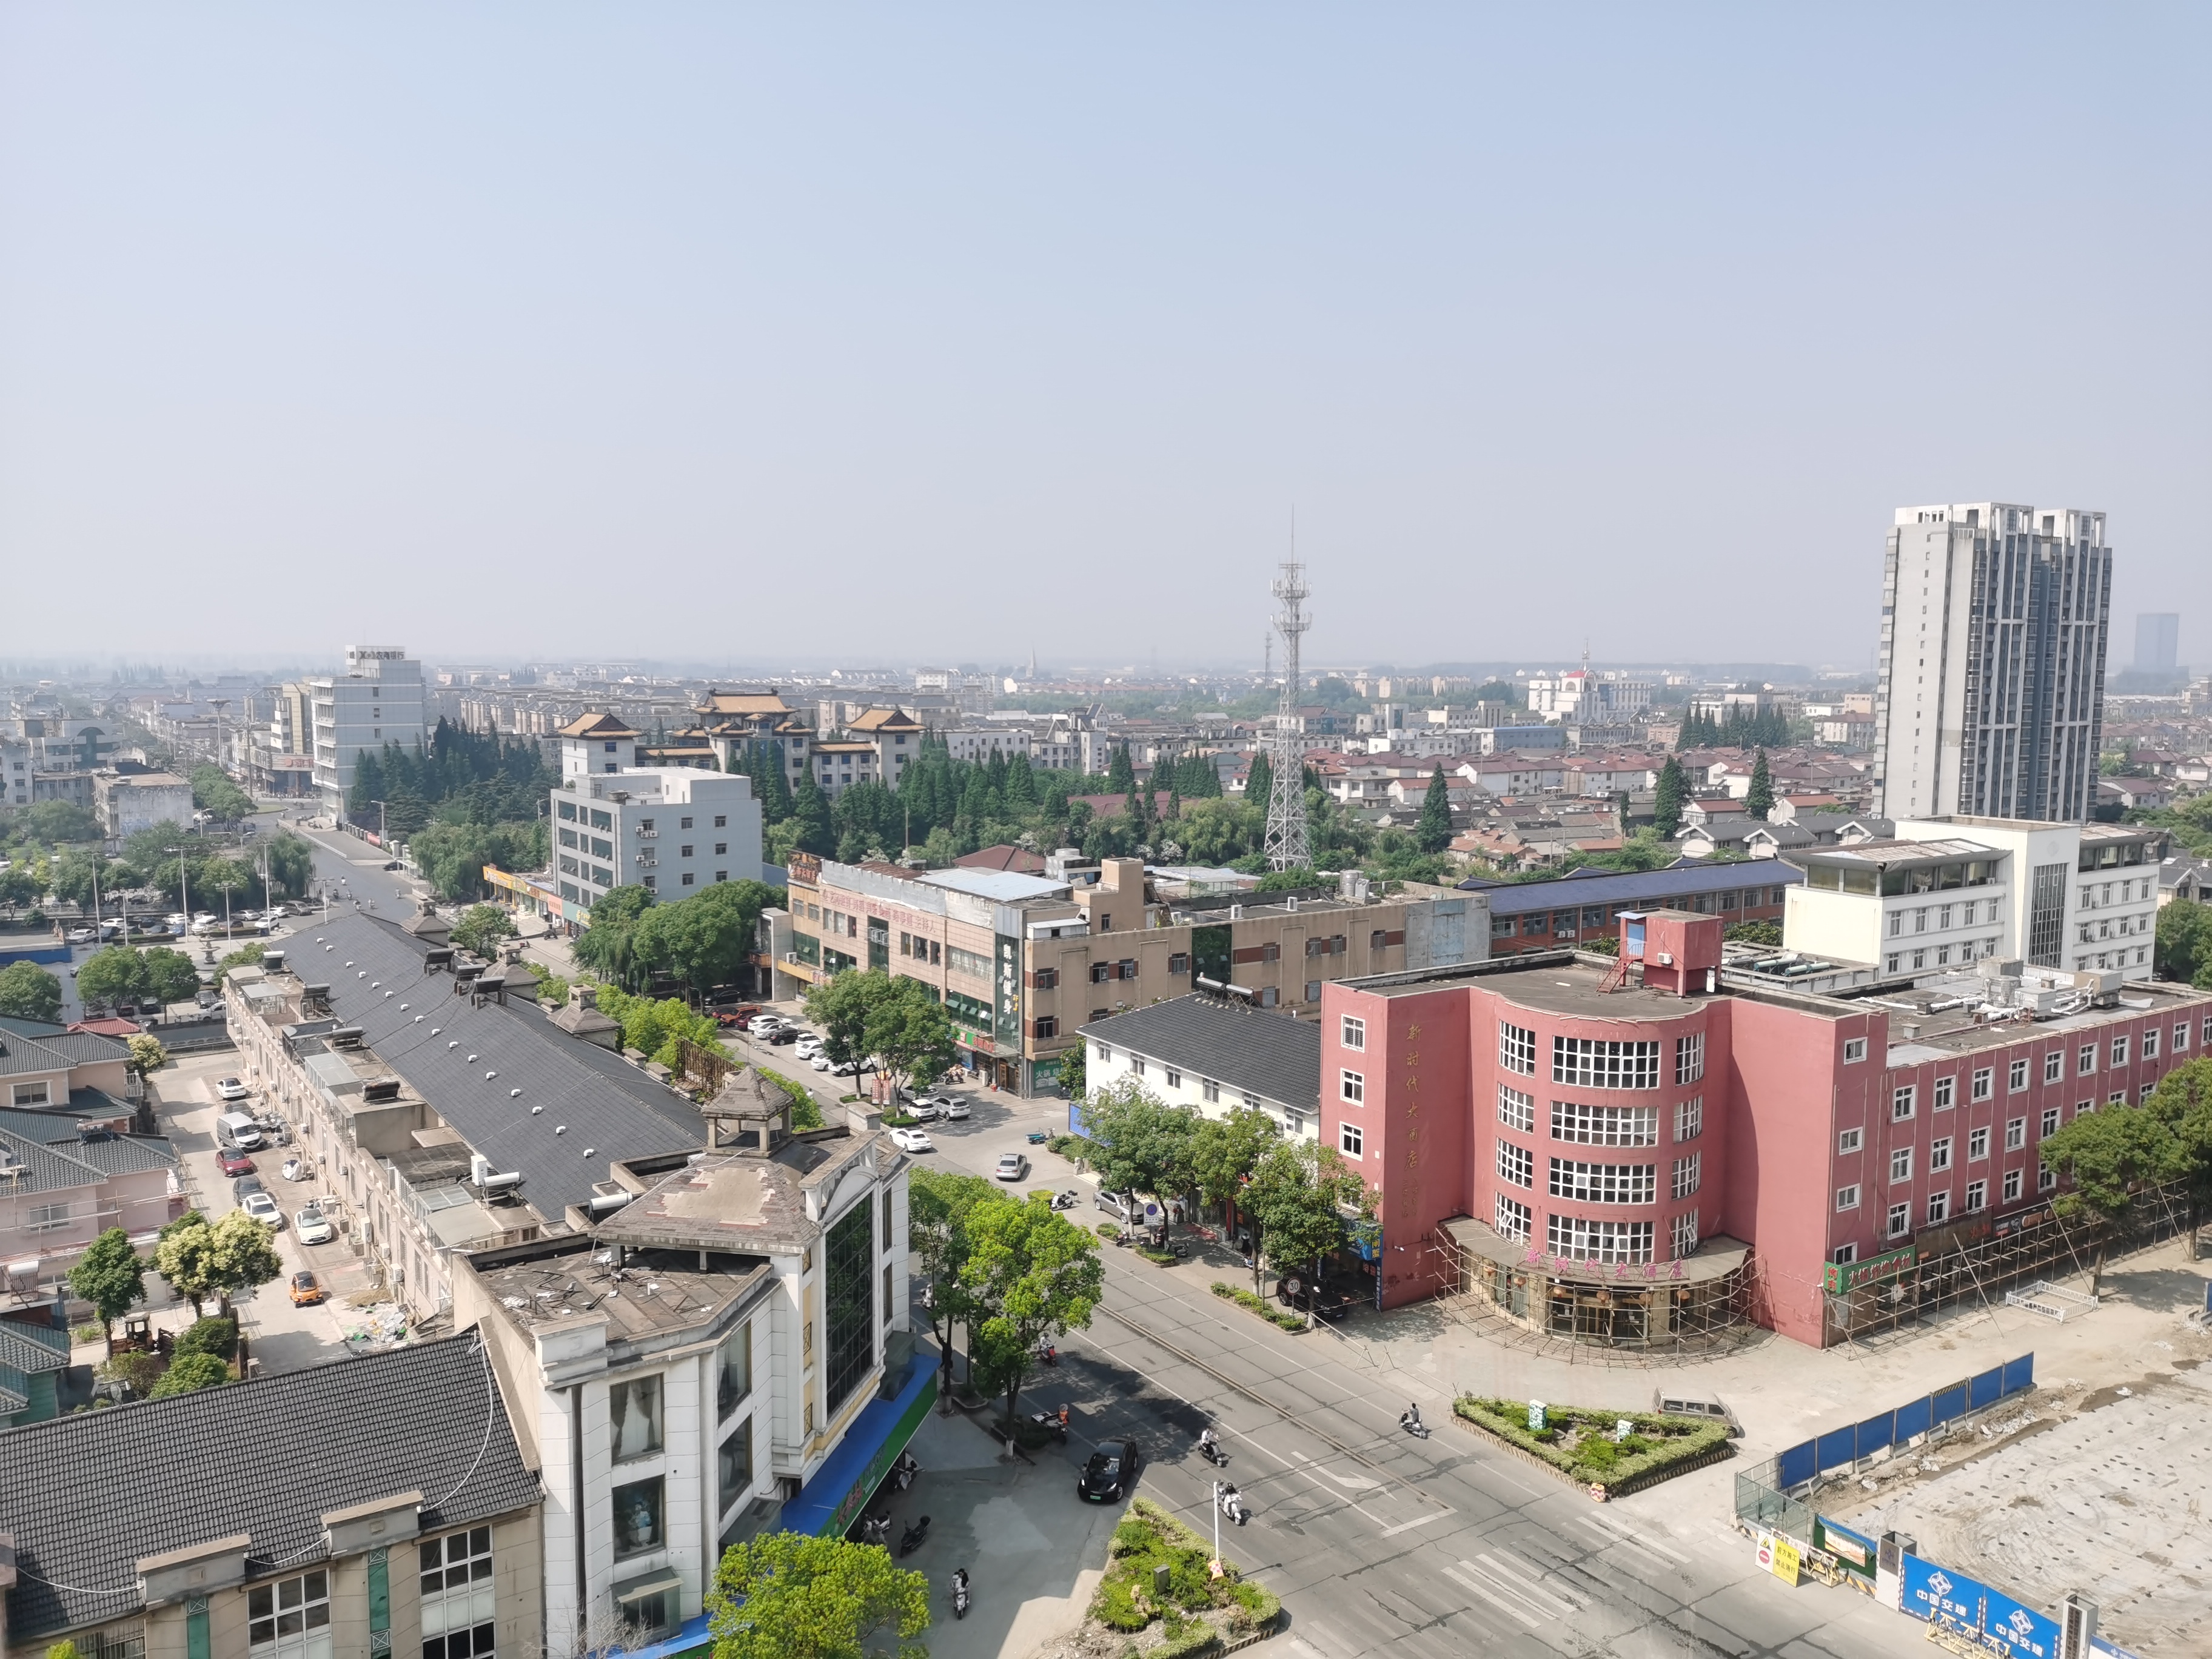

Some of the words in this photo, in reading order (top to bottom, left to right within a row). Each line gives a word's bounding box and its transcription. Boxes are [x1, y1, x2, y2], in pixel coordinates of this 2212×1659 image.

[1526, 1248, 1683, 1279] 新时代大酒店
[1290, 1282, 1299, 1291] 30
[1777, 1546, 1797, 1563] 前方施工
[1775, 1558, 1796, 1575] 禁止通行
[1916, 1589, 1967, 1617] 中国交建
[1995, 1622, 2044, 1658] 中国交建
